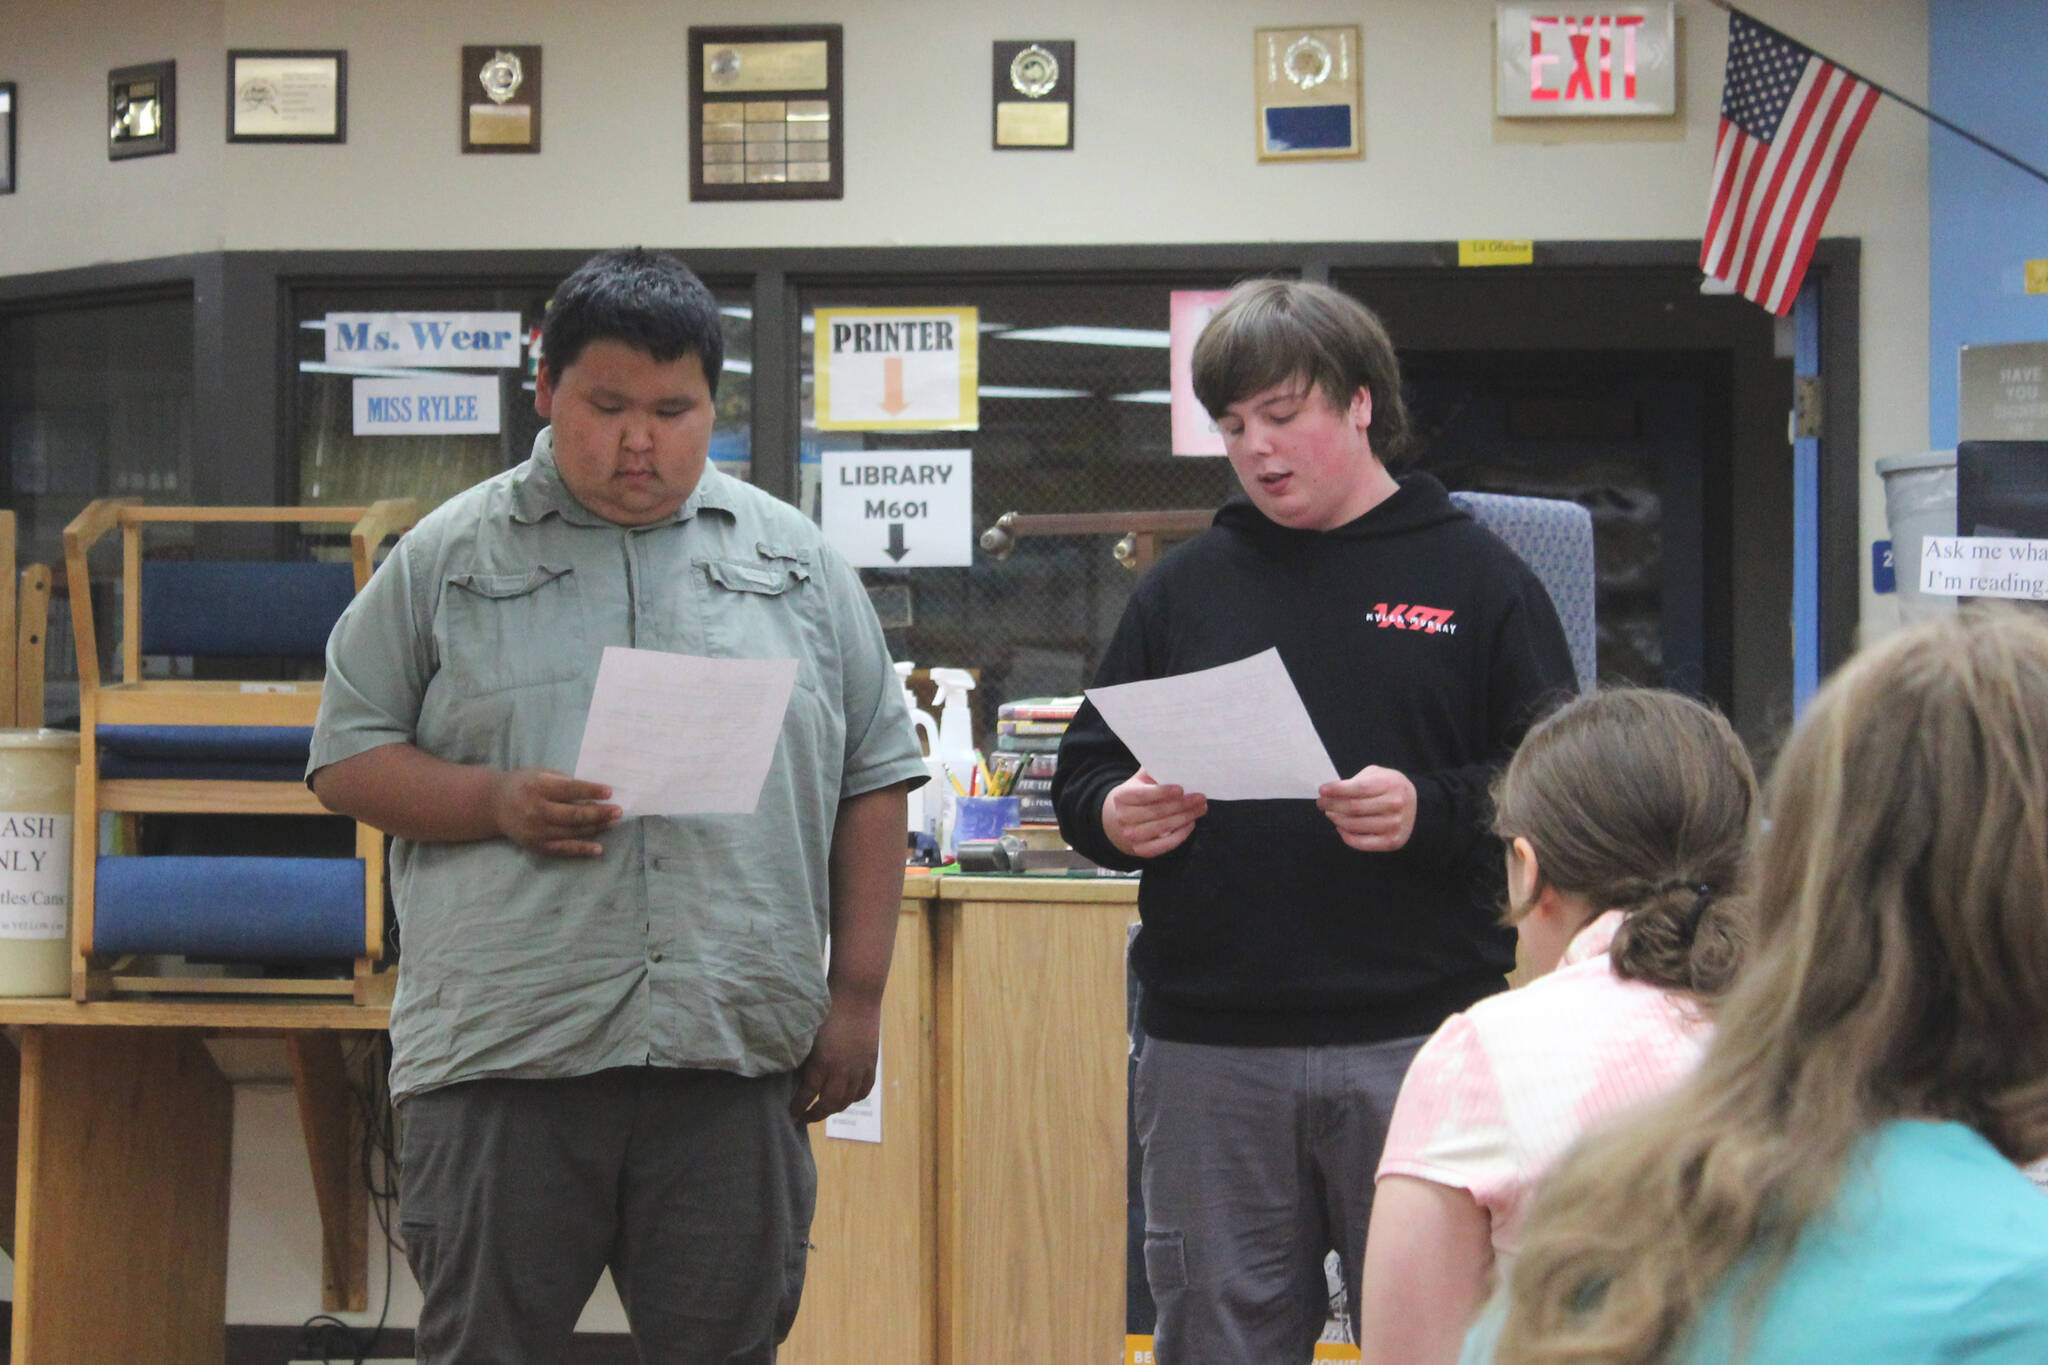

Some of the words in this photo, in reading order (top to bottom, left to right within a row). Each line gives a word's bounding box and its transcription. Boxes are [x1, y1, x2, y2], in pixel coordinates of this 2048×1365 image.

[1530, 16, 1645, 101] EXIT
[334, 322, 400, 351] Ms.
[408, 321, 512, 351] Wear
[833, 321, 954, 353] PRINTER
[1999, 365, 2043, 384] HAVE
[2005, 385, 2040, 401] YOU
[366, 396, 412, 423] MISS
[418, 395, 479, 422] RYLEE
[840, 465, 953, 486] LIBRARY
[864, 499, 928, 519] M601
[1925, 540, 1963, 560] Ask
[1971, 545, 2001, 560] me
[2009, 542, 2048, 561] wha
[1928, 570, 1962, 590] I'm
[1969, 572, 2048, 598] reading.
[1365, 612, 1405, 626] KYLER
[1409, 615, 1457, 635] MURRAY
[1, 816, 54, 839] ASH
